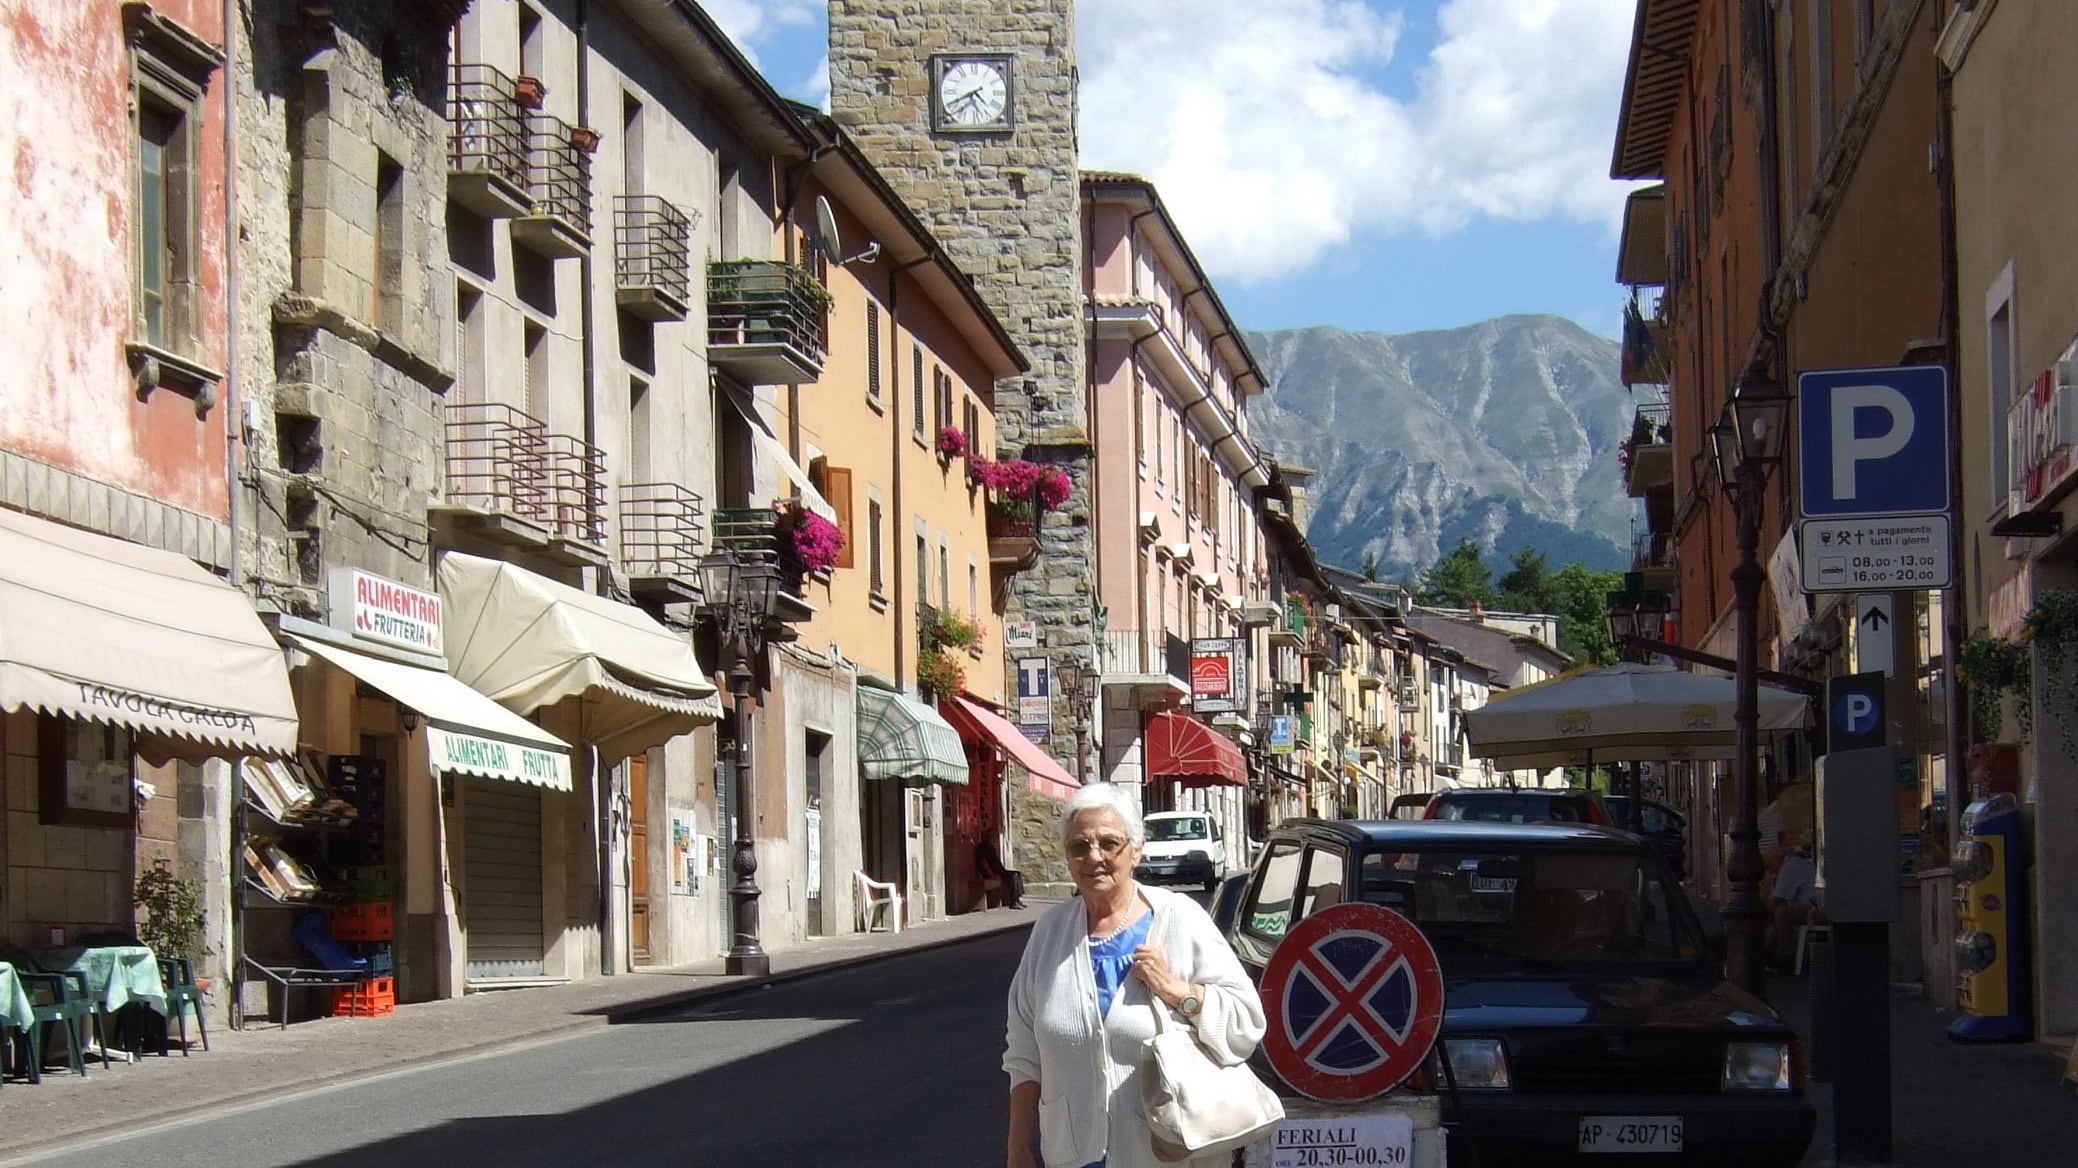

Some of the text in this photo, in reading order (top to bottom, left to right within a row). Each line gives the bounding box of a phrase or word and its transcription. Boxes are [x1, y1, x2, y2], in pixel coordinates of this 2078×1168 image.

[1831, 385, 1915, 500] P
[1871, 536, 1892, 546] tutti
[1902, 535, 1930, 546] giorni
[1877, 526, 1931, 536] pagamento
[358, 577, 440, 626] ALIMENTARI
[374, 613, 425, 644] FRUTTERIA
[1020, 658, 1046, 696] T
[76, 682, 256, 736] TAVOLA CALDA
[1847, 694, 1872, 732] P
[445, 735, 560, 782] ALIMENTARI FRUTTA
[1277, 1128, 1357, 1145] FERIALI
